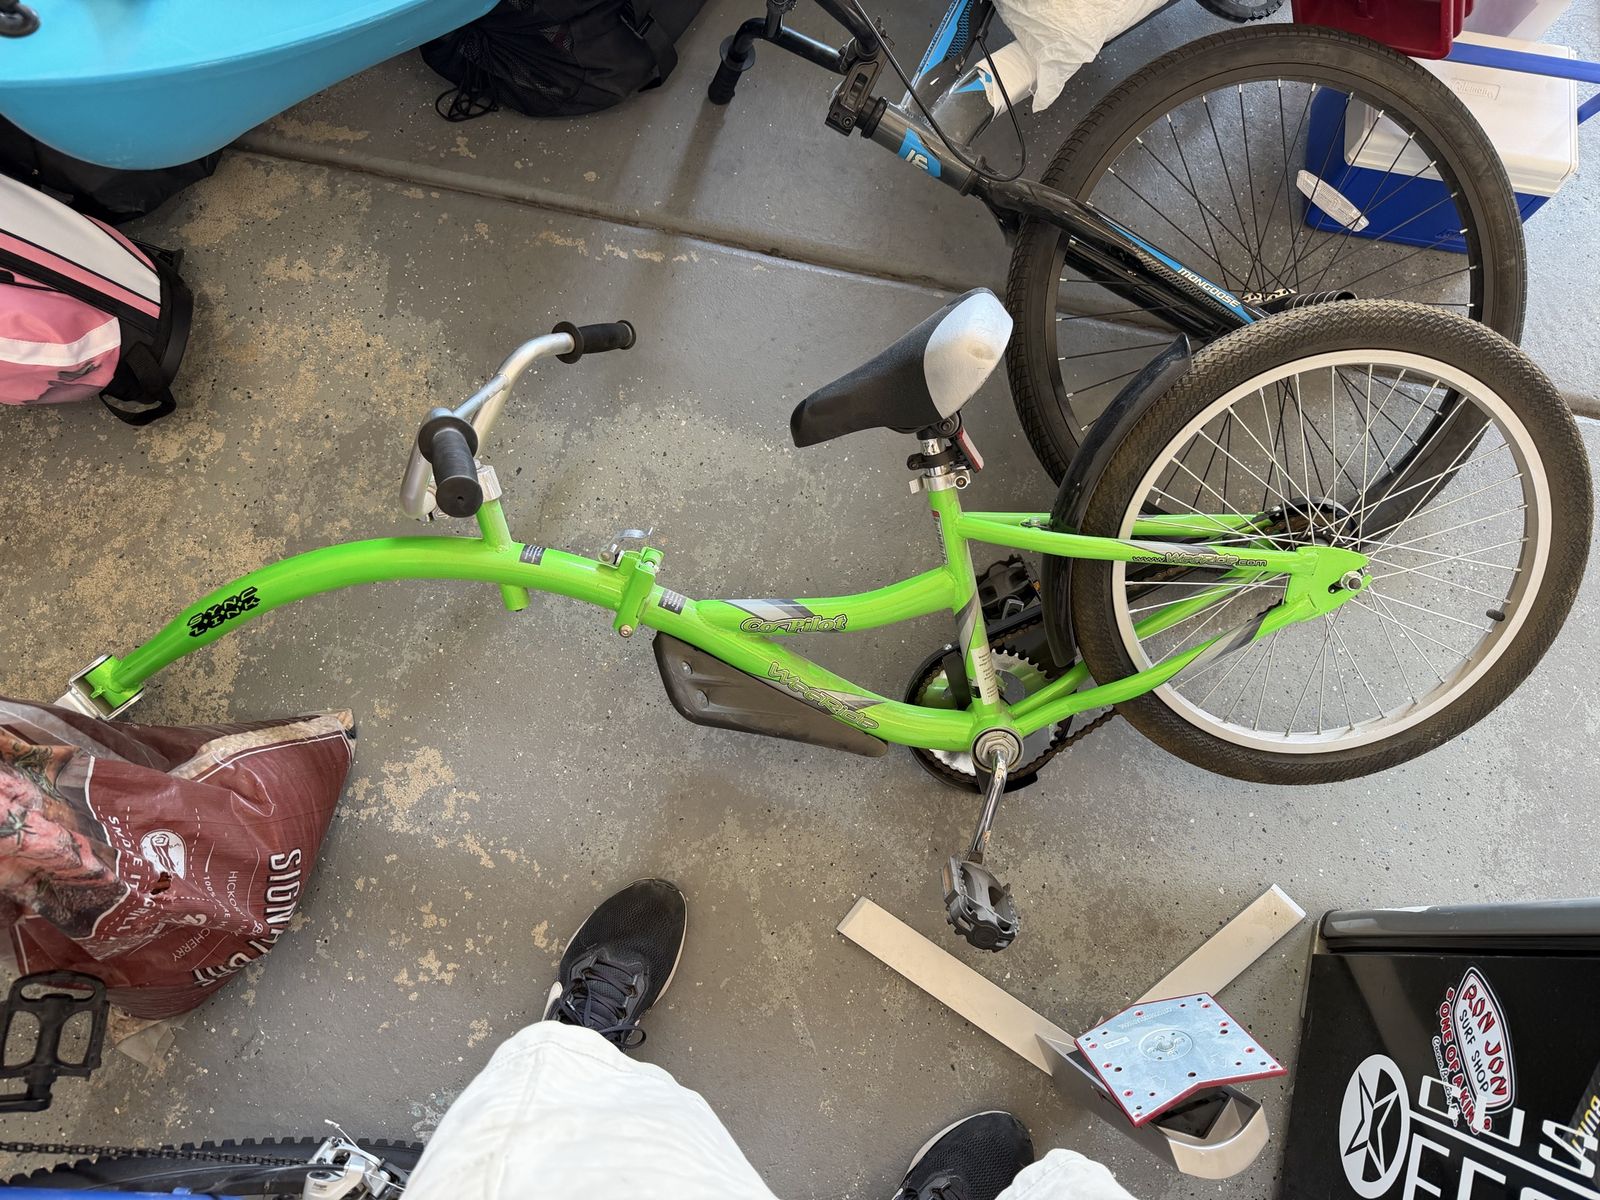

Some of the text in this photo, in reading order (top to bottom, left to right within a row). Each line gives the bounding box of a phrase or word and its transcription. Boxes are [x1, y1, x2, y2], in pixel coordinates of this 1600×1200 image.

[1177, 268, 1241, 308] MONGOOSE
[188, 587, 257, 626] SYNC
[190, 598, 260, 636] LINK
[768, 661, 880, 730] WeeRide
[172, 928, 211, 963] CHERRY
[1445, 1044, 1461, 1074] OF
[1459, 1008, 1490, 1093] SURF SHOP
[1462, 983, 1507, 1096] RON JON
